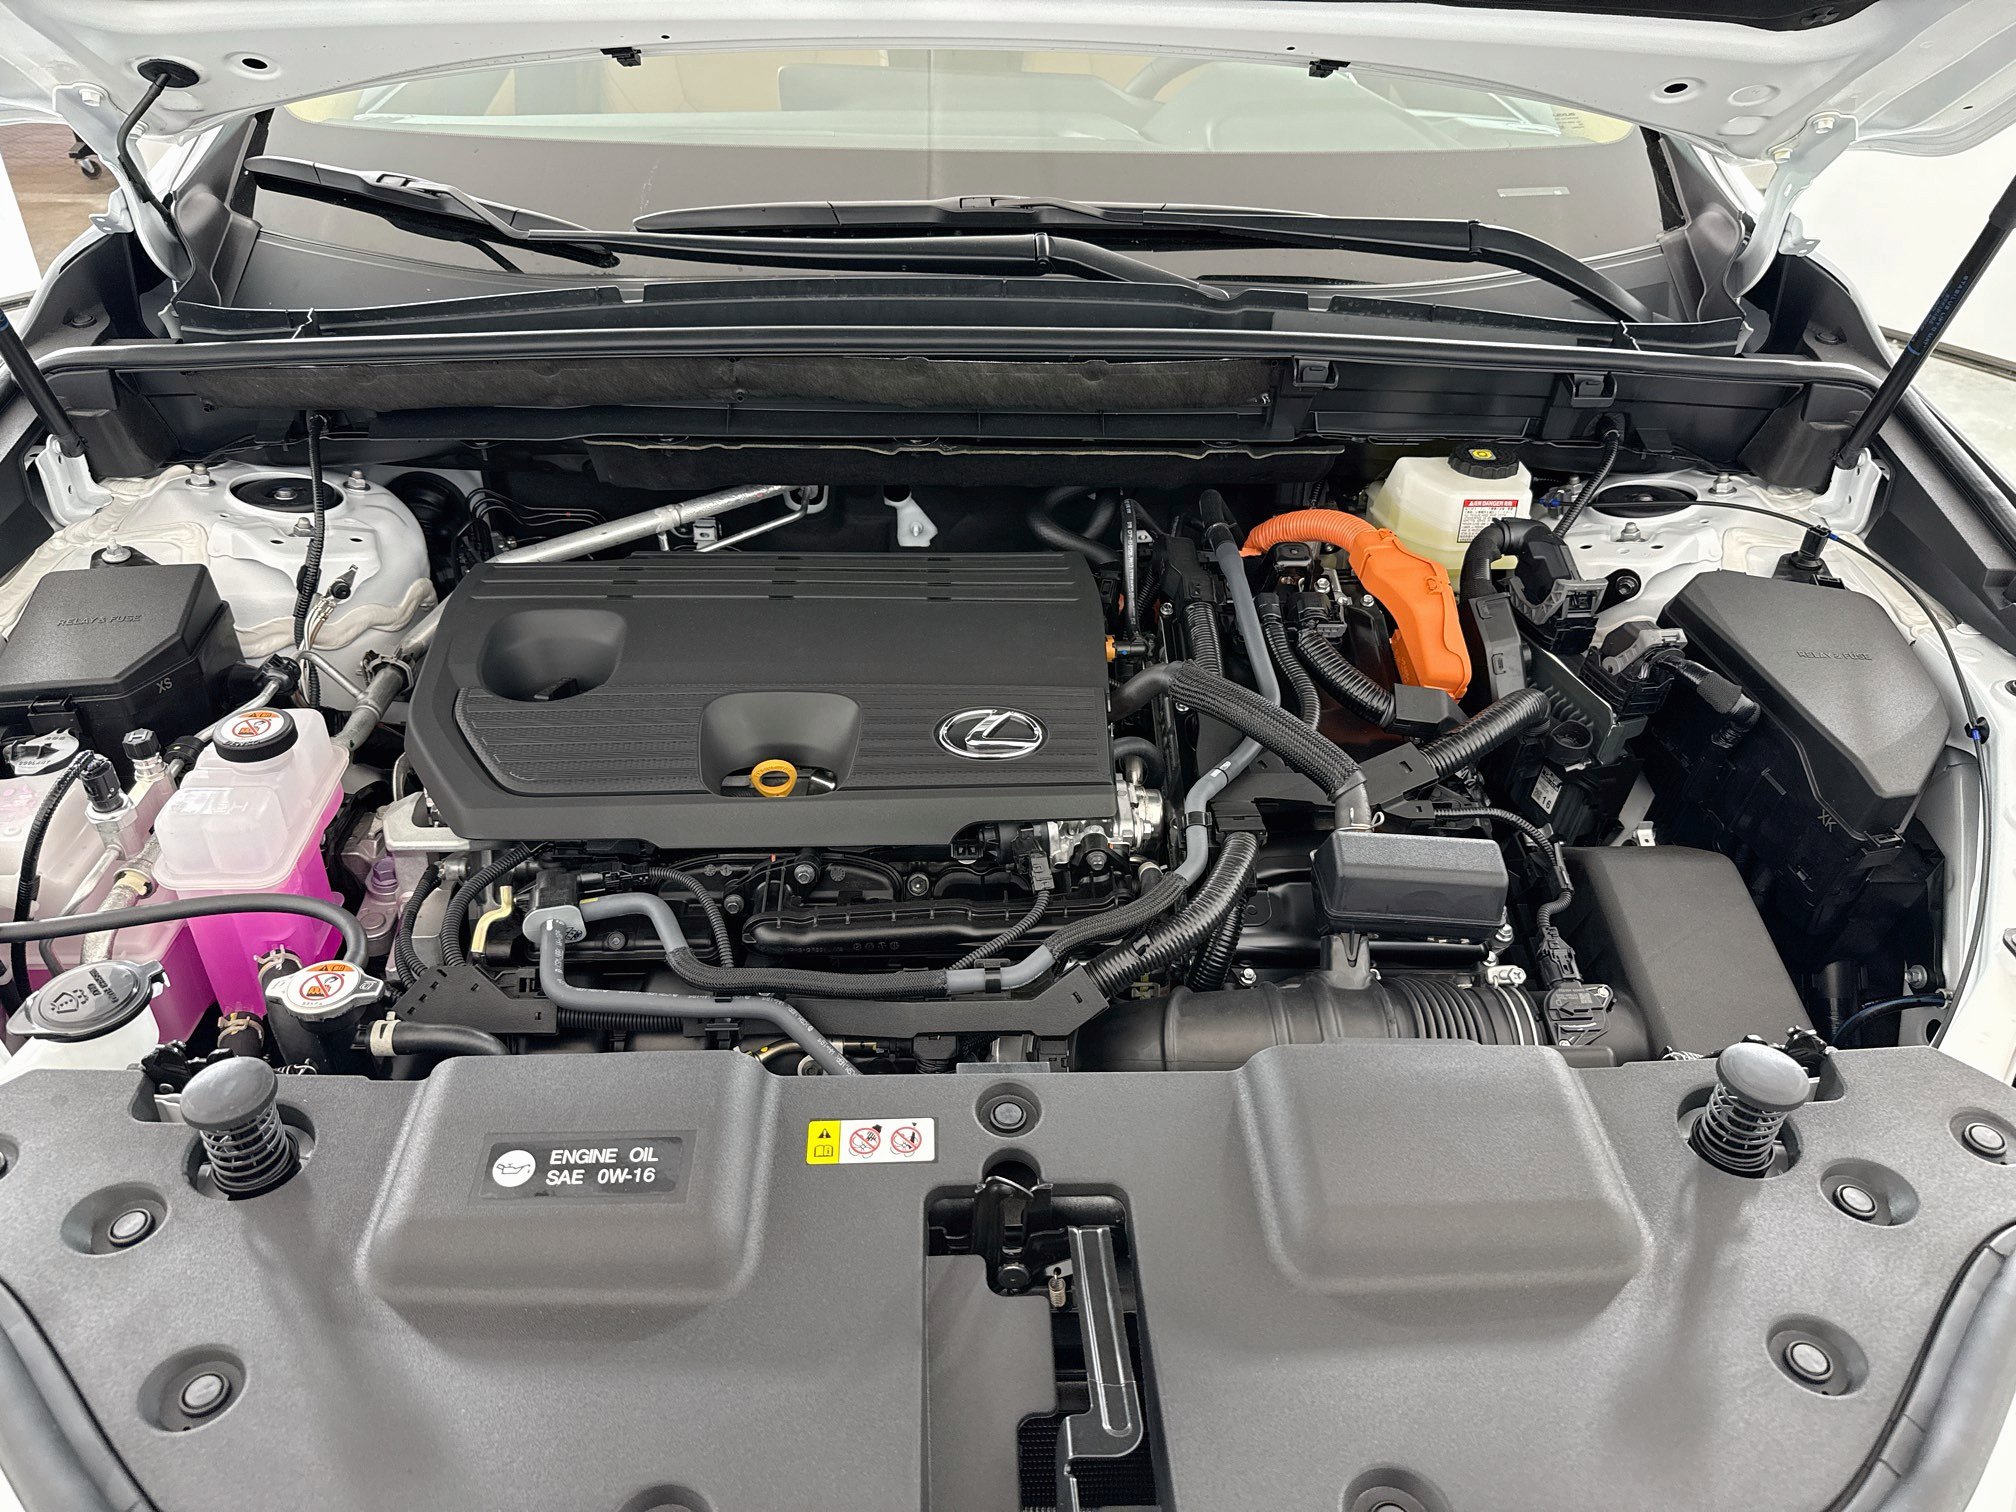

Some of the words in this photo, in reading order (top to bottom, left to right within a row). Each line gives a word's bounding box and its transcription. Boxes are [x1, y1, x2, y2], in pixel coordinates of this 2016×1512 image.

[56, 616, 98, 627] RELAY
[109, 614, 143, 623] FUSE
[1796, 650, 1832, 659] RELAY
[1842, 651, 1873, 661] FUSE
[156, 677, 173, 694] XS
[127, 730, 148, 742] H
[1542, 796, 1552, 810] 16
[1816, 808, 1838, 833] XK
[549, 1147, 618, 1165] ENGINE
[628, 1146, 659, 1162] OIL
[545, 1169, 585, 1186] SAE
[597, 1167, 656, 1184] 0W-16
